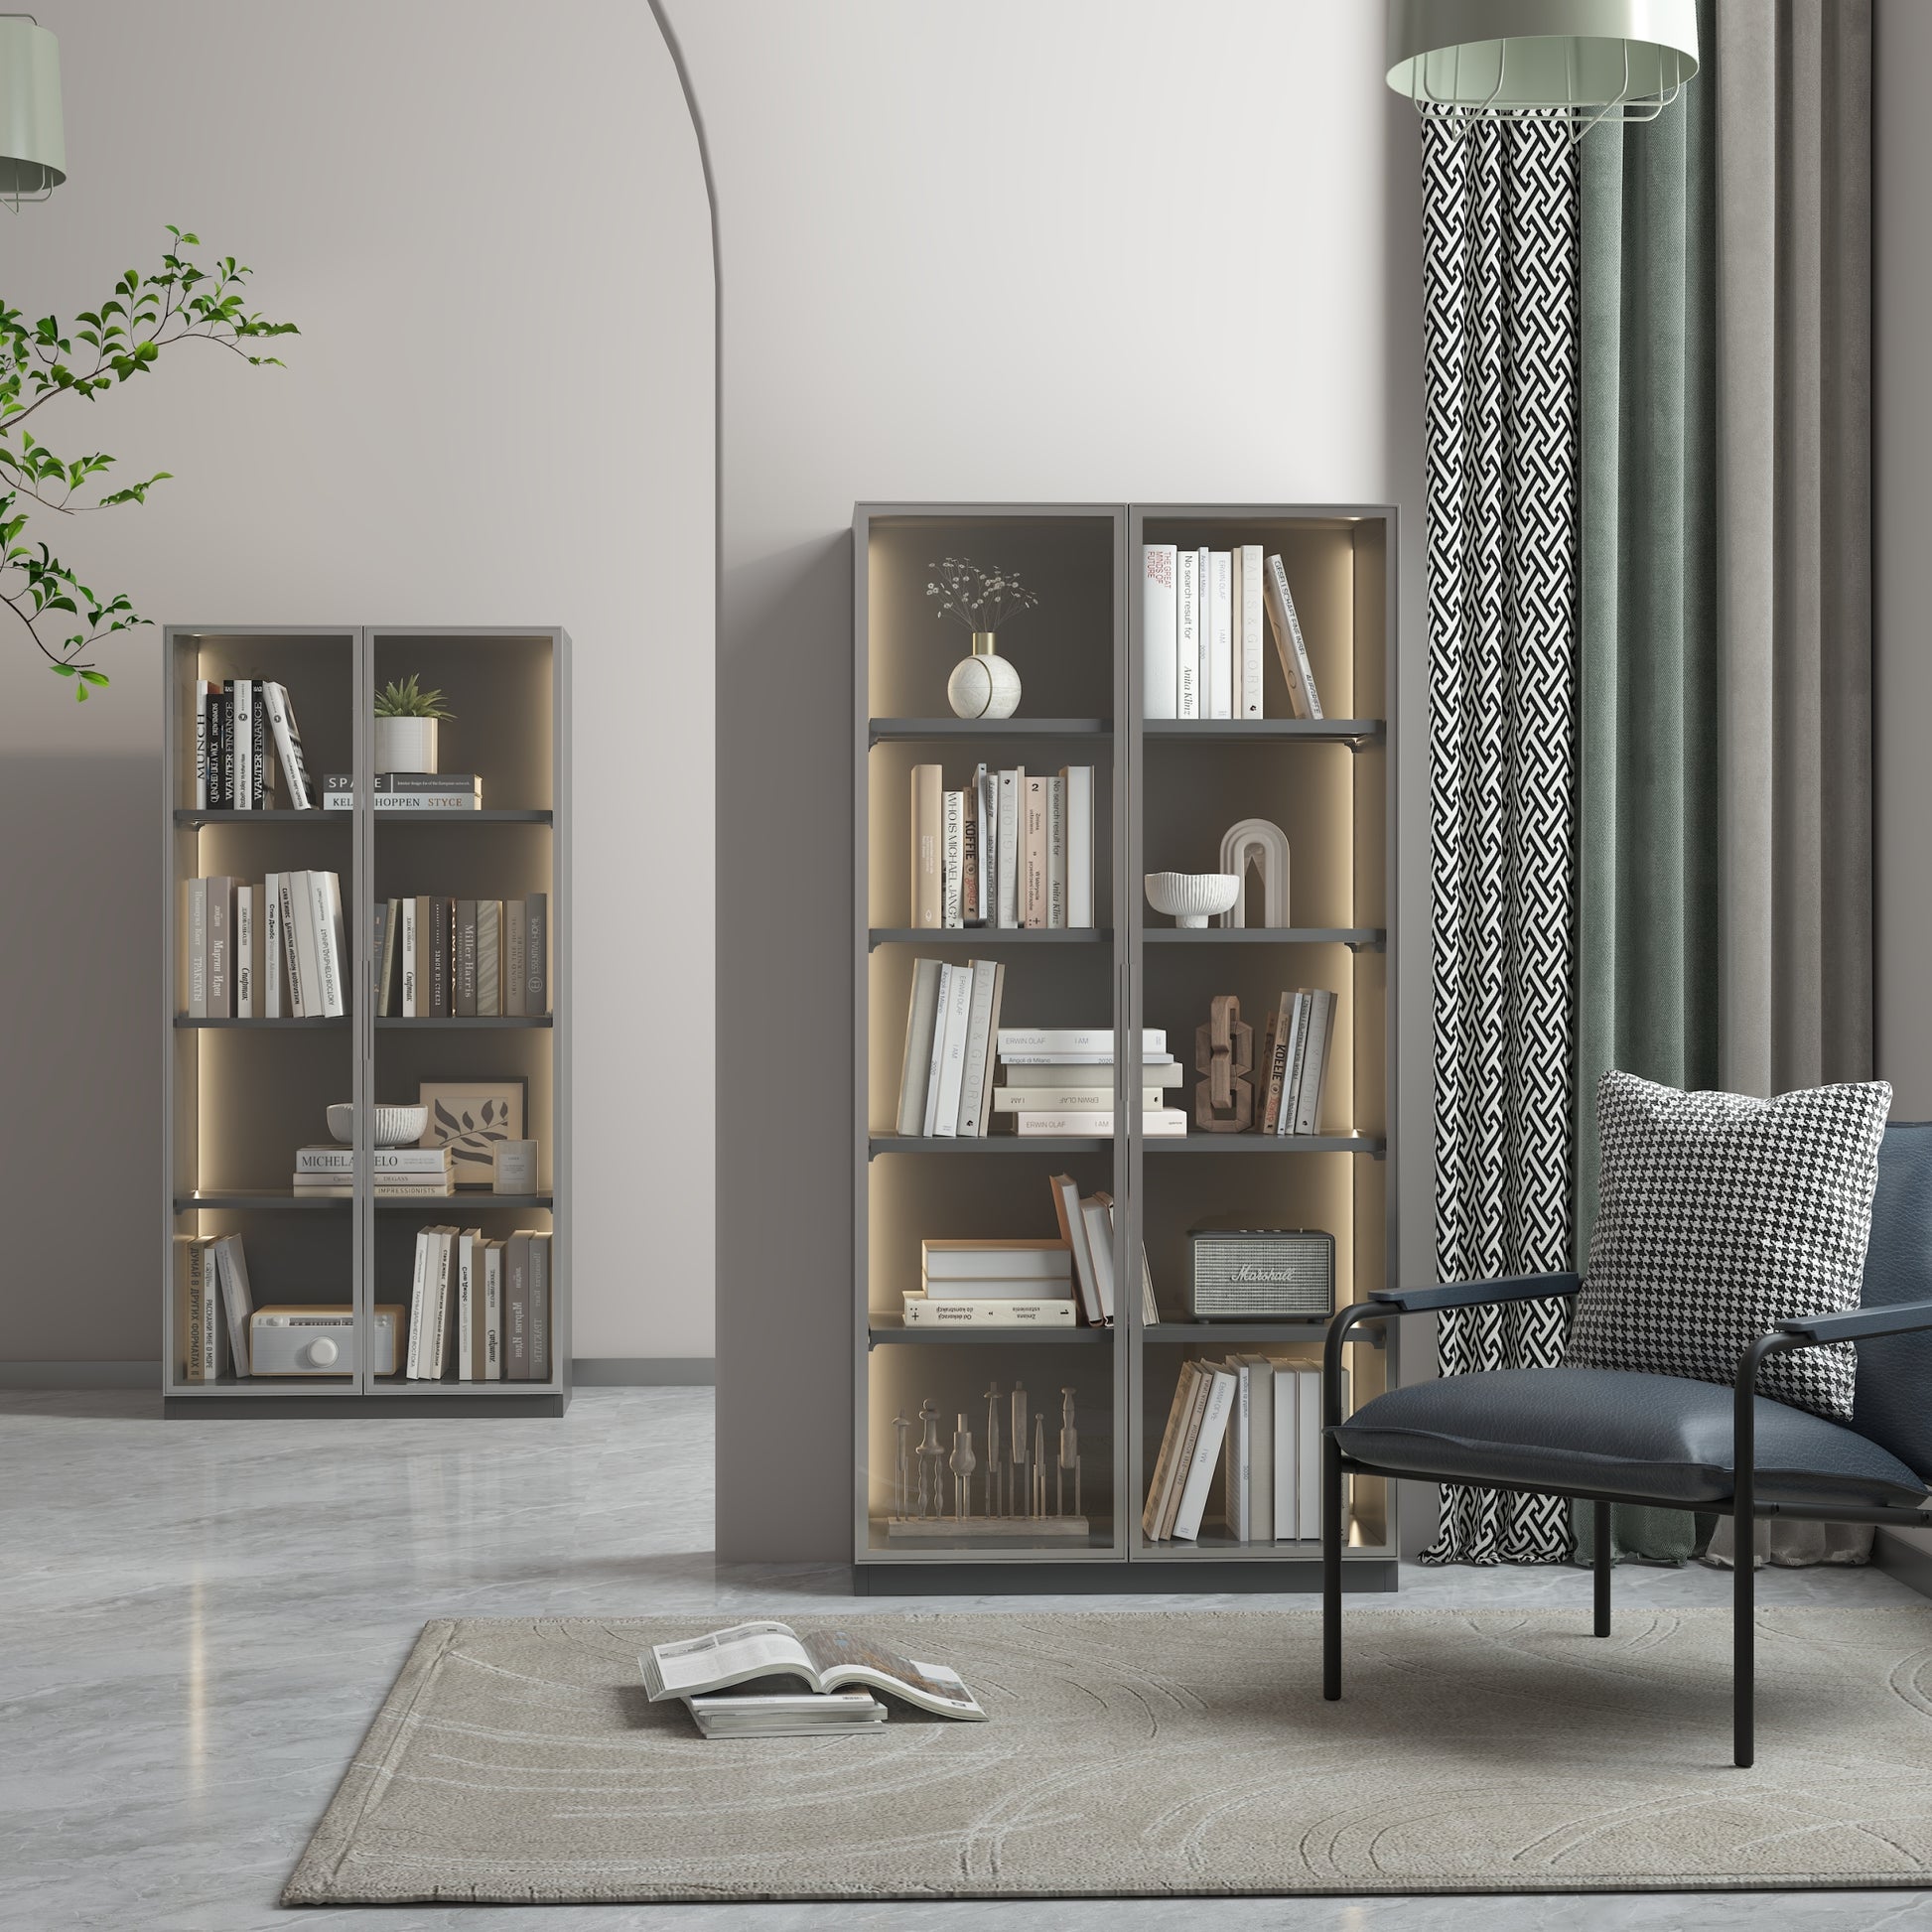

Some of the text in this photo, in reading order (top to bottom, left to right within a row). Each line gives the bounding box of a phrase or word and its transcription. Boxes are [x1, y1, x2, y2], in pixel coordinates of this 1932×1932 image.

[1156, 574, 1162, 584] OF
[1184, 555, 1192, 639] No search result for
[1184, 666, 1192, 716] Anita Klinz
[375, 798, 420, 807] HOPPEN
[1032, 784, 1039, 792] 2
[1054, 780, 1060, 792] No
[947, 792, 958, 919] WHO IS MICHAEL JANG?
[966, 821, 976, 860] KOFFIE
[1053, 880, 1061, 925] Anita Klinz
[212, 940, 224, 997] Мартин Иден
[465, 925, 474, 998] Miller Harris
[240, 967, 250, 1001] Спартак
[404, 971, 414, 1002] Спартак
[957, 975, 966, 997] ERWIN
[966, 1049, 982, 1113] GLORY
[190, 1248, 201, 1277] ДУМАЙ
[1231, 1264, 1296, 1281] Marshall
[190, 1288, 199, 1320] ДРУГИХ
[191, 1323, 199, 1367] ФОРМАТАХ
